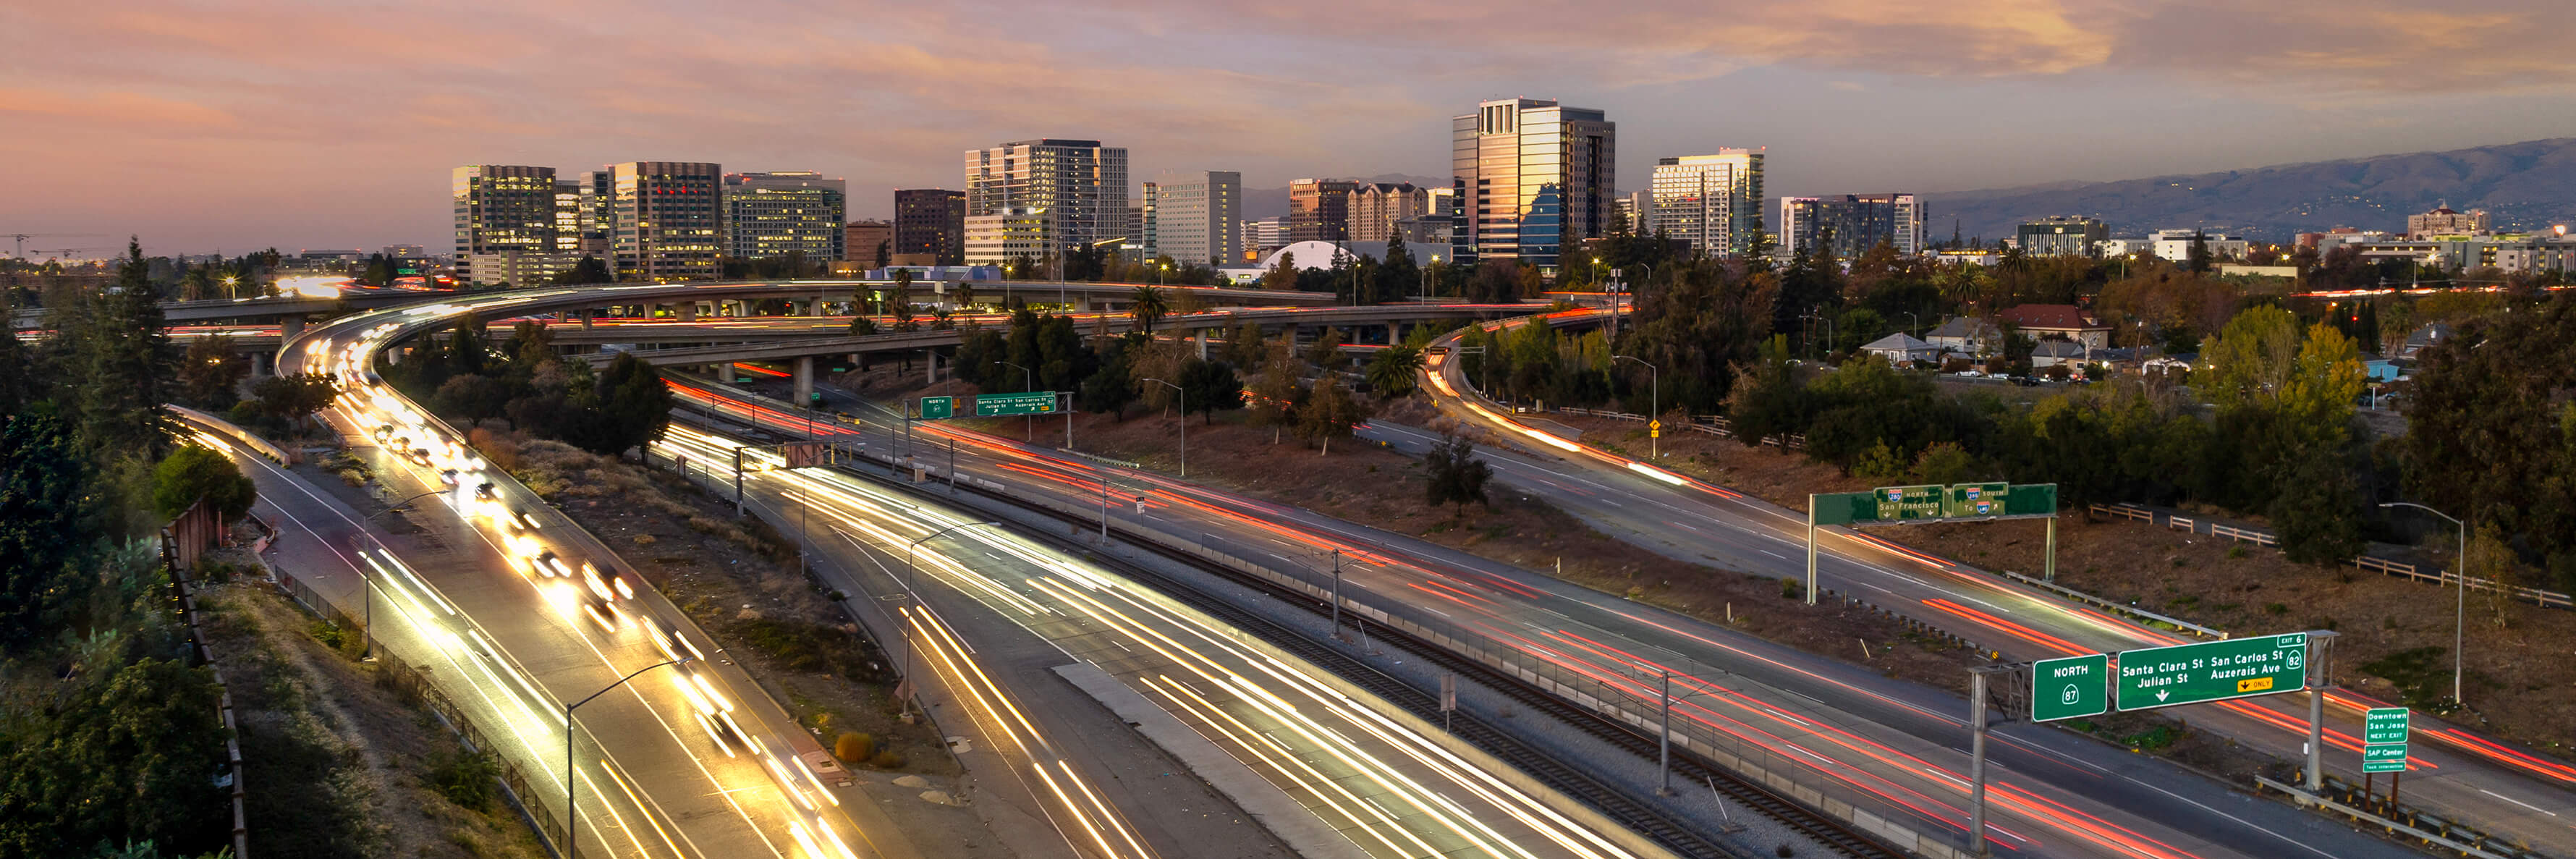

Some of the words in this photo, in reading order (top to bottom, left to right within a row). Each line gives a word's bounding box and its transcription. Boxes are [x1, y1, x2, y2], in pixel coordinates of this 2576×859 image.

[2211, 656, 2230, 667] San
[2234, 653, 2267, 664] Carlos
[2272, 650, 2284, 660] St
[2288, 656, 2300, 667] 82
[2054, 664, 2088, 678] NORTH
[2122, 664, 2154, 677] Santa
[2158, 662, 2187, 673] Clara
[2192, 658, 2204, 669] St
[2210, 665, 2257, 680] Auzerais
[2261, 664, 2280, 674] Ave
[2137, 675, 2172, 688] Julian
[2177, 673, 2188, 683] St
[2064, 690, 2076, 701] 87
